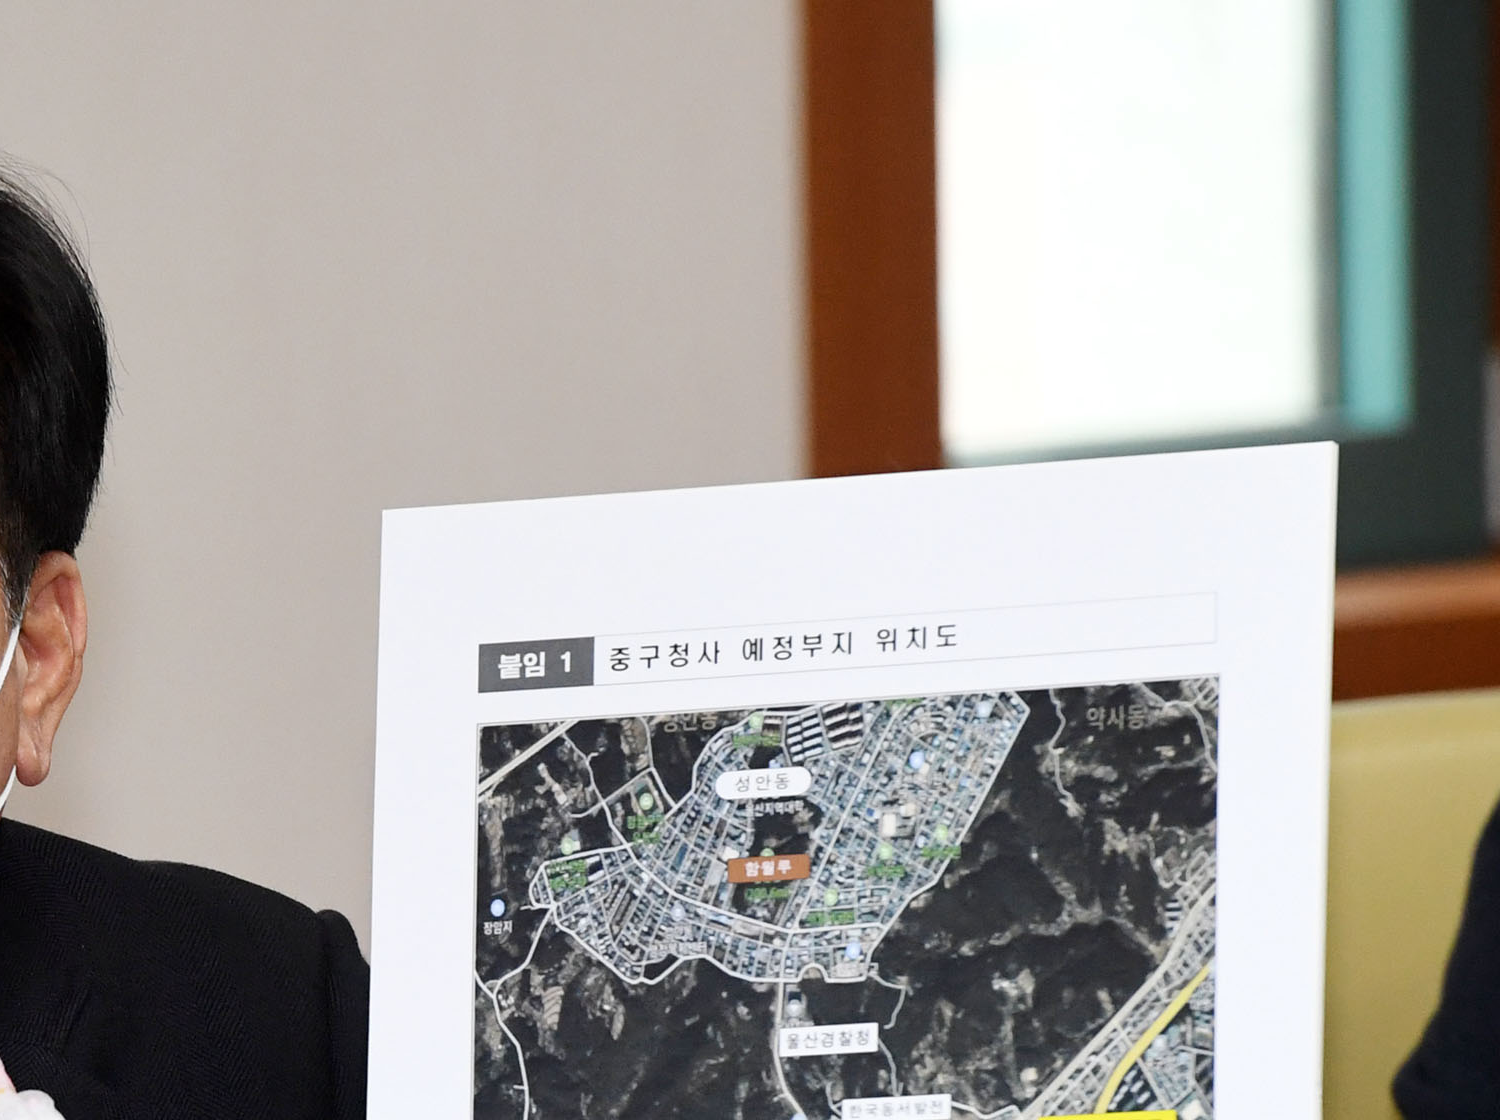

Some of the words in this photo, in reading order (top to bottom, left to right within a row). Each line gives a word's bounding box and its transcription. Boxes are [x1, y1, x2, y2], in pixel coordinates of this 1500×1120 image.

[609, 641, 721, 672] 중구청사
[742, 631, 854, 662] 예정부지
[876, 624, 958, 653] 위치도
[497, 651, 547, 679] 붙임
[560, 651, 571, 673] 1
[1086, 704, 1145, 731] 약사동
[735, 773, 791, 793] 성안동
[786, 1029, 870, 1050] 울산경찰청
